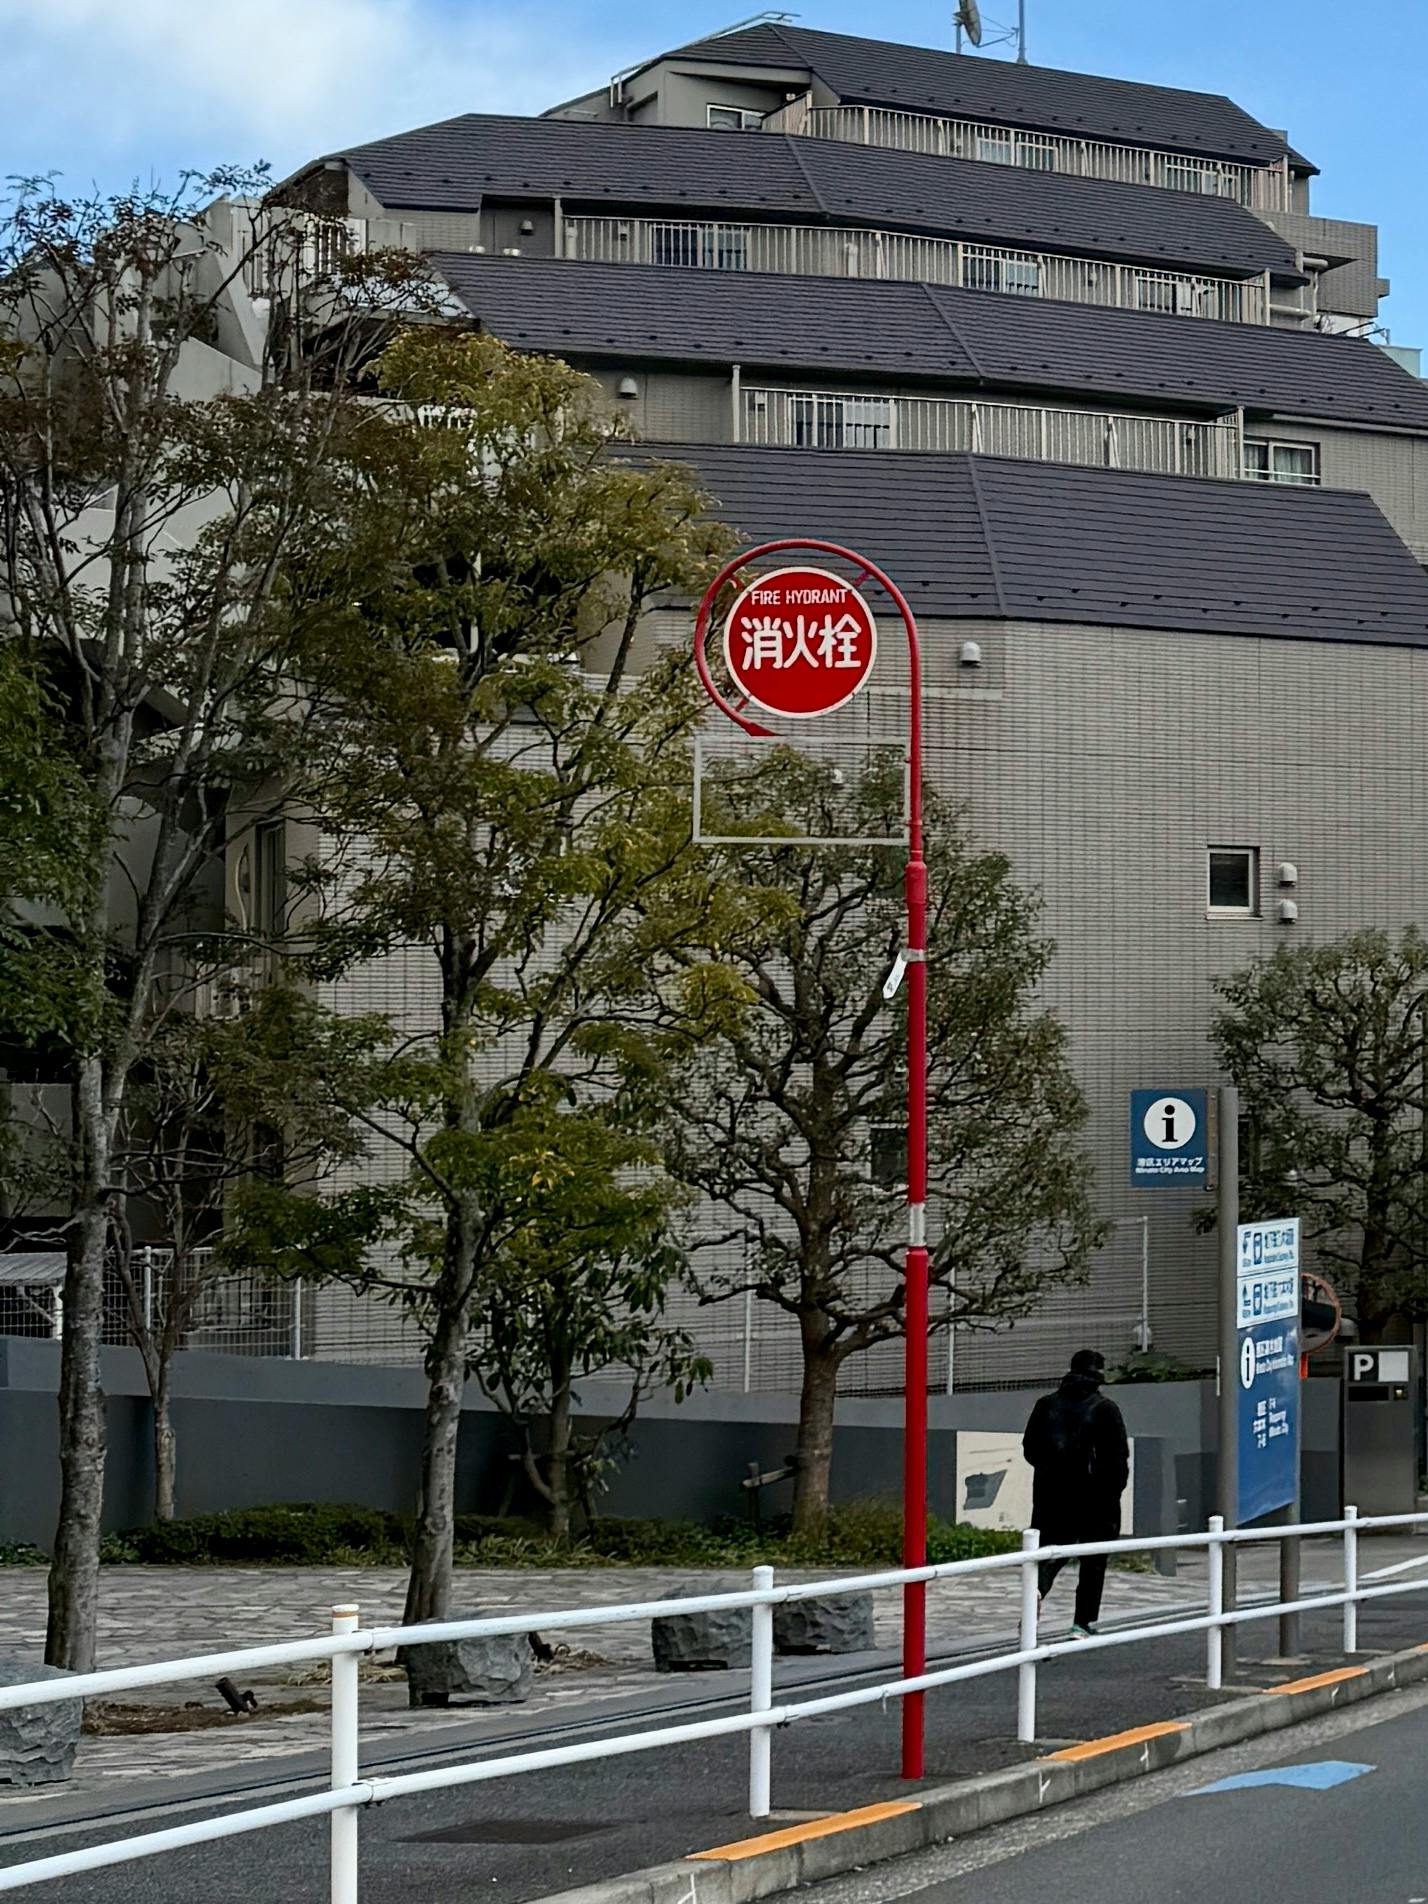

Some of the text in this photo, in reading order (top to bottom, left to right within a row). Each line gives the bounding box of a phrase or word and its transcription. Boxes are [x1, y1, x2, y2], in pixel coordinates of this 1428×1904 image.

[751, 588, 848, 605] FIRE HYDRANT
[740, 613, 862, 670] 消火栓
[1353, 1353, 1375, 1381] P
